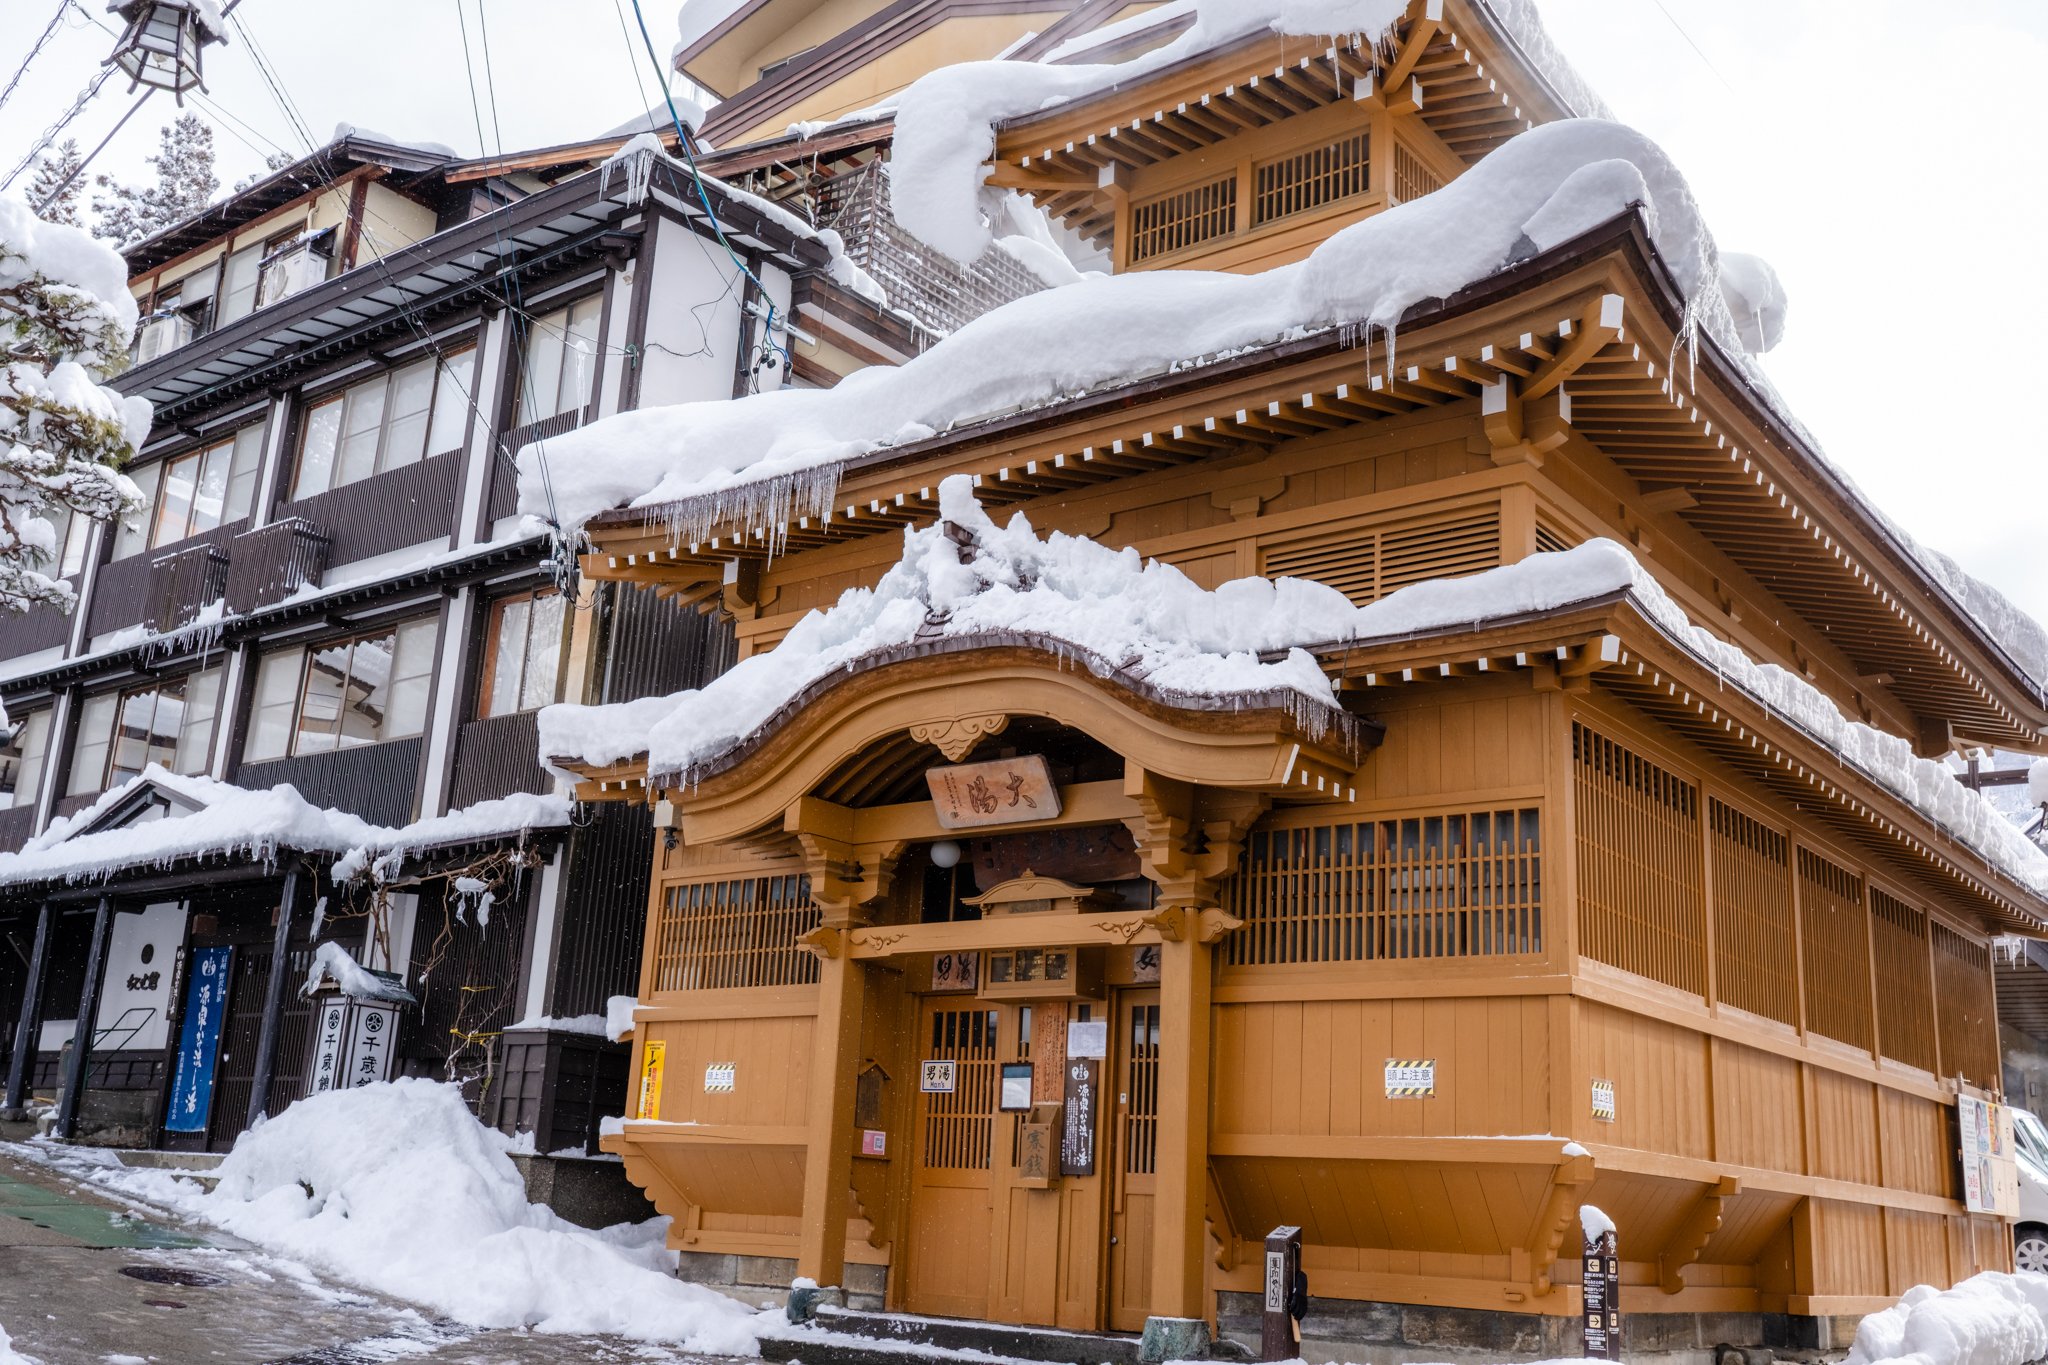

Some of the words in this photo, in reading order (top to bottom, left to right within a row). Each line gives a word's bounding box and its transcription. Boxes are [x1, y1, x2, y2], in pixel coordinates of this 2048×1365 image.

[926, 1065, 950, 1080] 男湯
[1387, 1069, 1432, 1081] 頭上注意
